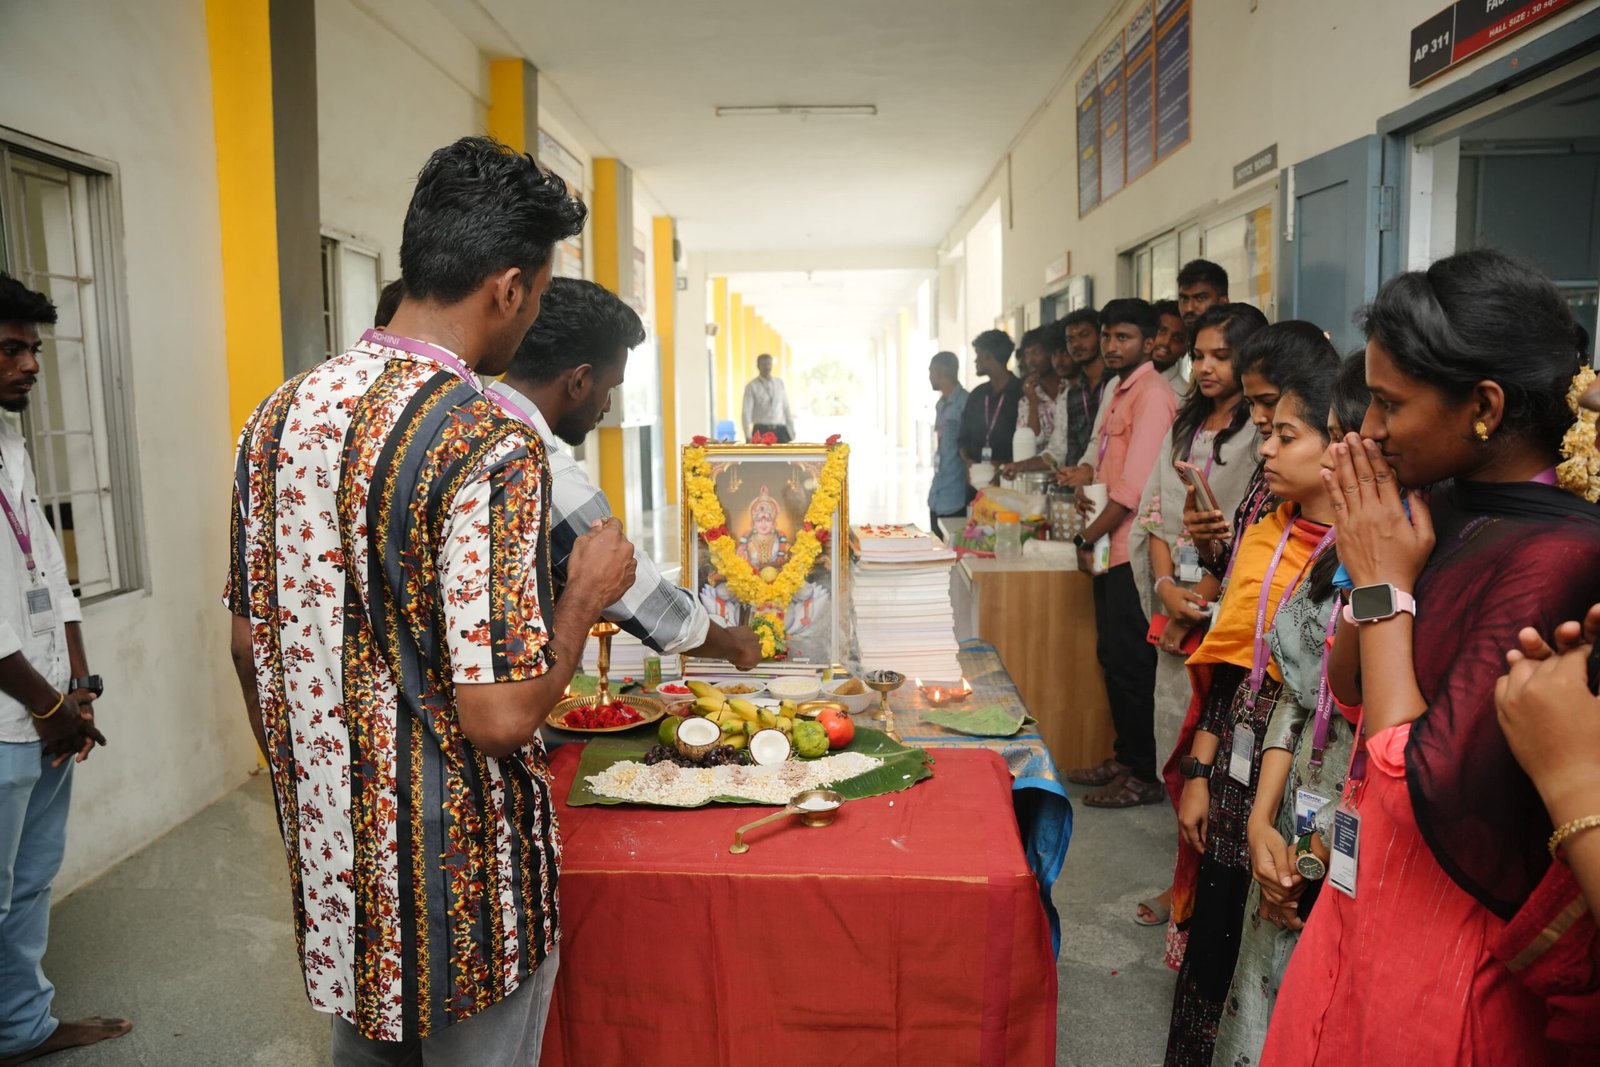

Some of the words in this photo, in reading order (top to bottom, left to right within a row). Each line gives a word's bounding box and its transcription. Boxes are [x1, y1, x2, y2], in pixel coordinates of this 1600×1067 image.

[1489, 23, 1507, 38] HALL
[1509, 11, 1526, 27] SIZE
[1531, 3, 1542, 15] 30
[1414, 43, 1429, 63] AP
[1430, 31, 1450, 53] 311
[371, 332, 400, 345] ROHINI
[1255, 608, 1265, 640] ROHINI
[1317, 676, 1327, 712] ROHINI
